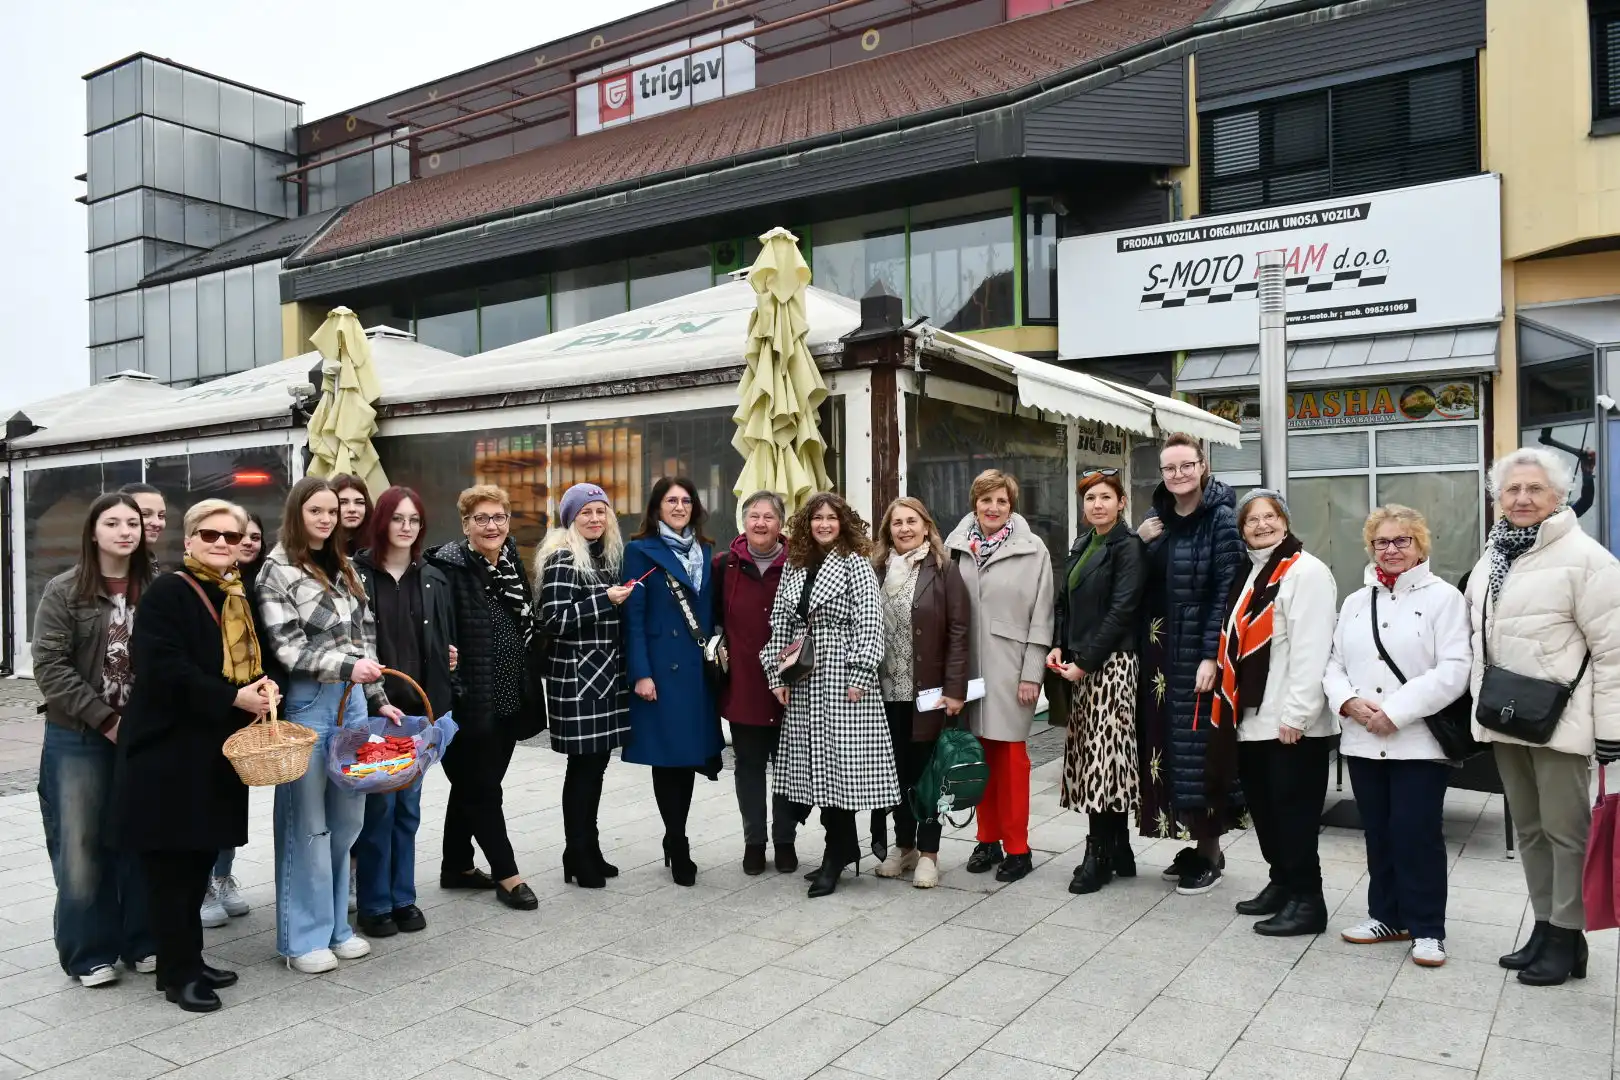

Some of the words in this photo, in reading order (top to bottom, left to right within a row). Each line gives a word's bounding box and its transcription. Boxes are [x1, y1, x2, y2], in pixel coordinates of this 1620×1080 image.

[640, 57, 722, 100] triglav
[1123, 235, 1164, 250] PRODAJA
[1166, 229, 1201, 244] VOZILA
[1203, 229, 1207, 239] I
[1209, 219, 1280, 237] ORGANIZACIJA
[1282, 213, 1319, 228] UNOSA
[1321, 207, 1361, 223] VOZILA
[1143, 254, 1244, 292] S-MOTO
[1253, 243, 1329, 279] TAM
[1333, 247, 1390, 270] d.o.o.
[1344, 308, 1363, 317] mob.
[1365, 303, 1409, 315] 098241069
[553, 317, 725, 351] PAN
